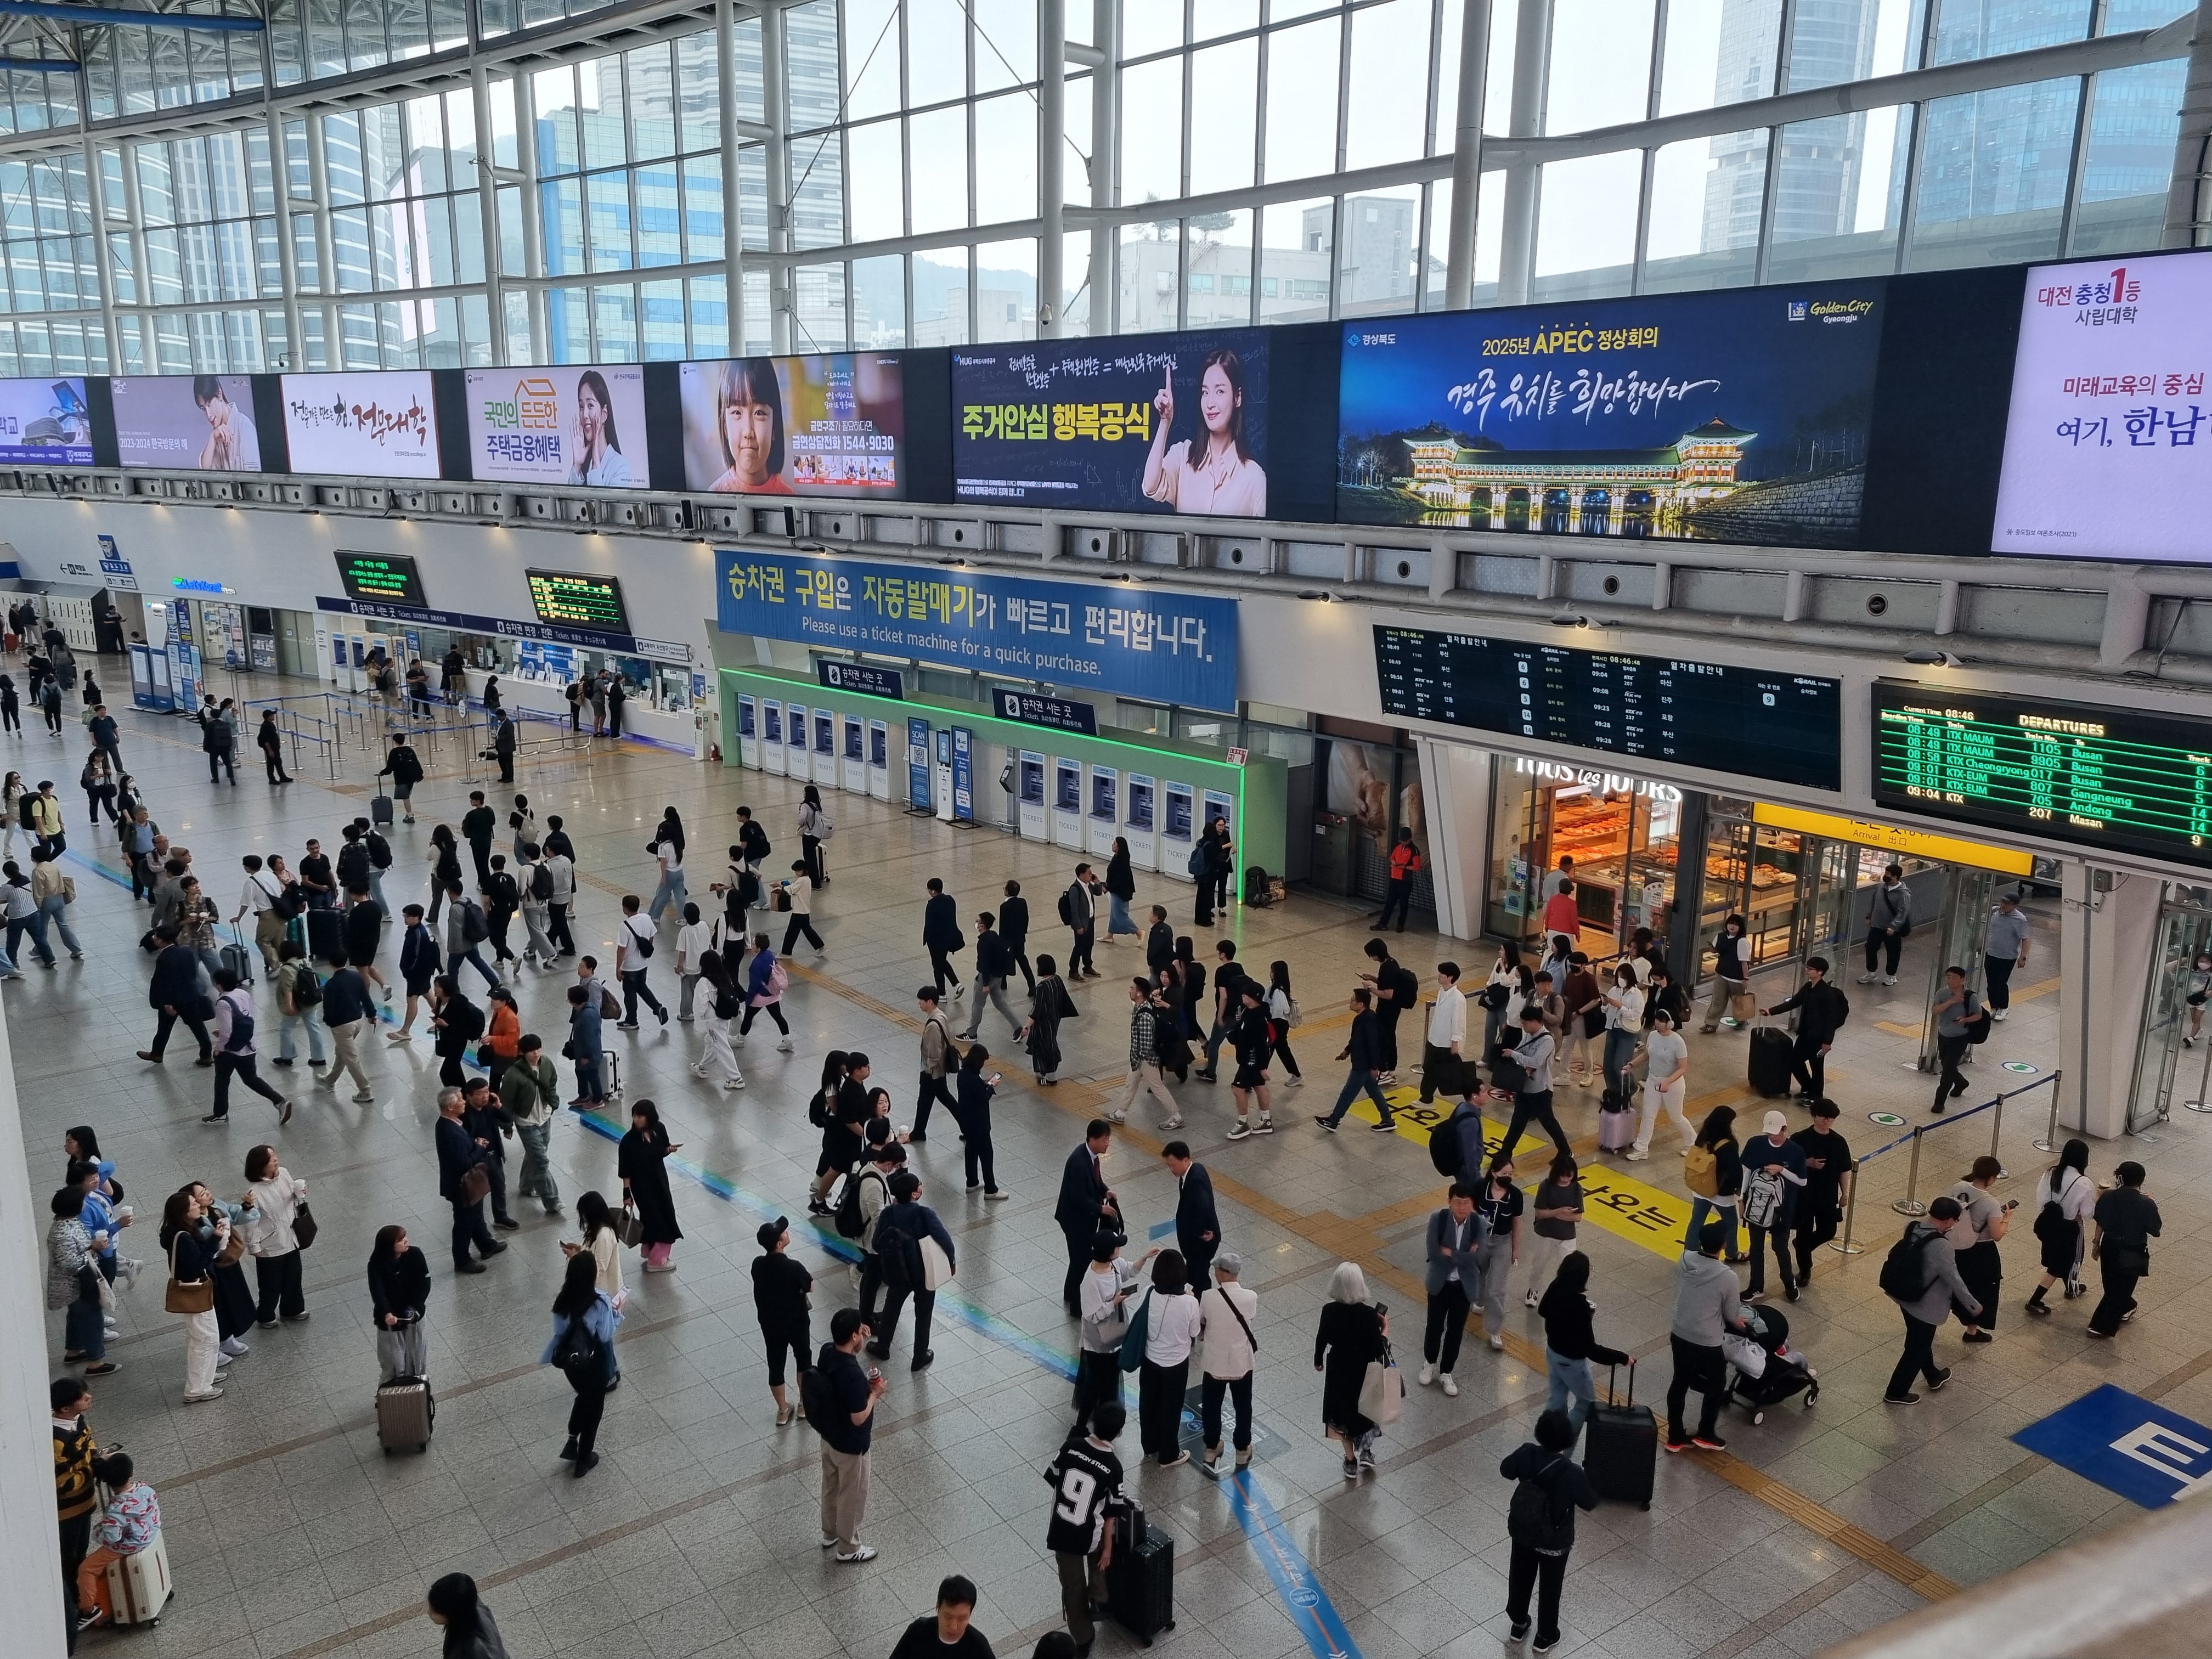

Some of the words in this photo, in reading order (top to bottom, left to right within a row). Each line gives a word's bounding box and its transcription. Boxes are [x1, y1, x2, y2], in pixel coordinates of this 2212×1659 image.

[2038, 285, 2072, 307] 대전
[1823, 314, 1857, 324] Gyeongju
[2075, 306, 2138, 326] 사립대학
[1362, 334, 1396, 346] 경상북도
[1482, 337, 1530, 356] 2025년
[1533, 328, 1593, 355] APEC
[1597, 326, 1658, 351] 정상회의
[960, 357, 972, 365] HUG
[2063, 374, 2157, 397] 미래교육의
[2163, 373, 2204, 396] 중심
[1447, 368, 1496, 432] 경주
[1500, 371, 1566, 422] 유치를
[1569, 369, 1720, 426] 희망합니다
[352, 393, 426, 447] 전문대학
[484, 396, 520, 428] 국민의
[521, 400, 557, 429] 든든한
[963, 404, 1048, 441] 주거안심
[1052, 402, 1150, 441] 행복공식
[810, 420, 840, 432] 금연구조가
[842, 420, 873, 431] 필요하다면
[2057, 417, 2112, 447] 여기,
[2123, 405, 2212, 447] 한남
[120, 438, 150, 448] 2023-2024
[152, 438, 180, 450] 한국방문의
[181, 439, 188, 450] 해
[487, 435, 561, 463] 주택금융혜택
[792, 435, 841, 450] 금연상담전화
[729, 562, 785, 603] 승차권
[795, 569, 851, 611] 구입은
[863, 575, 996, 630] 자동발매기가
[1007, 597, 1070, 635] 빠르고
[1085, 606, 1212, 662] 편리합니다.
[505, 622, 523, 636] 승차권
[524, 624, 537, 637] 변경
[555, 631, 569, 640] Tickets
[802, 616, 836, 635] Please
[839, 625, 857, 637] use
[861, 628, 868, 639] a
[871, 625, 903, 644] ticket
[907, 632, 957, 652] machine
[961, 637, 979, 656] for
[983, 645, 991, 658] a
[995, 645, 1031, 665] quick
[1035, 652, 1101, 676] purchase.
[842, 668, 860, 680] 승차권
[862, 671, 874, 683] 사는
[876, 673, 883, 685] 곳
[843, 679, 856, 687] Tickets
[1794, 678, 1817, 686] KORAIL
[1022, 698, 1043, 713] 승차권
[1046, 702, 1061, 716] 사는
[1064, 706, 1071, 718] 곳
[1024, 711, 1039, 720] Tickets
[1904, 706, 1926, 714] Current
[1945, 709, 1974, 720] 08:46
[1662, 730, 1674, 738] 부산
[2019, 714, 2104, 736] DEPARTURES
[912, 730, 925, 740] SCAN
[1907, 715, 1925, 724] Time
[1946, 721, 1965, 729] Train
[2024, 731, 2042, 741] Train
[2044, 735, 2058, 743] No.
[2187, 754, 2211, 764] Track
[1907, 724, 1940, 738] 08:49
[1947, 730, 1961, 740] ITX
[1963, 732, 1994, 745] MAUM
[2032, 742, 2061, 755] 1105
[2072, 748, 2102, 761] Busan
[2196, 765, 2205, 776] 6
[817, 763, 833, 771] TICKETS
[1907, 736, 1940, 750] 08:49
[1947, 742, 1961, 752] ITX
[1963, 745, 1994, 758] MAUM
[2030, 755, 2061, 769] 9905
[2072, 761, 2102, 775] Busan
[2196, 780, 2204, 790] 6
[847, 769, 863, 777] TICKETS
[873, 775, 886, 785] TICKETS
[1577, 769, 1600, 787] les
[1907, 749, 1940, 762] 08:58
[1947, 755, 1963, 766] KTX
[1965, 759, 2029, 777] Cheongryong
[2030, 768, 2052, 781] 017
[2071, 775, 2102, 788] Busan
[2195, 794, 2203, 804] 5
[1907, 761, 1938, 774] 09:01
[1946, 768, 1988, 782] KTX-EUM
[2030, 781, 2052, 793] 807
[2071, 788, 2132, 807] Gangneung
[2191, 807, 2207, 819] 14
[1907, 774, 1938, 787] 09:01
[1946, 780, 1988, 795] KTX-EUM
[2030, 794, 2052, 806] 705
[2069, 802, 2112, 818] Andong
[2191, 820, 2206, 833] 14
[1023, 813, 1042, 823] TICKETS
[1907, 786, 1940, 800] 09:04
[1946, 792, 1963, 804] KTX
[2029, 807, 2052, 820] 207
[2069, 814, 2103, 829] Masan
[2192, 835, 2202, 847] 9
[1058, 821, 1079, 832] TICKETS
[1093, 830, 1114, 840] TICKETS
[1130, 839, 1152, 850] TICKETS
[1853, 829, 1880, 841] Arrival
[1888, 836, 1907, 846] 出口
[1167, 849, 1189, 860] TICKETS
[1056, 1468, 1097, 1526] 9
